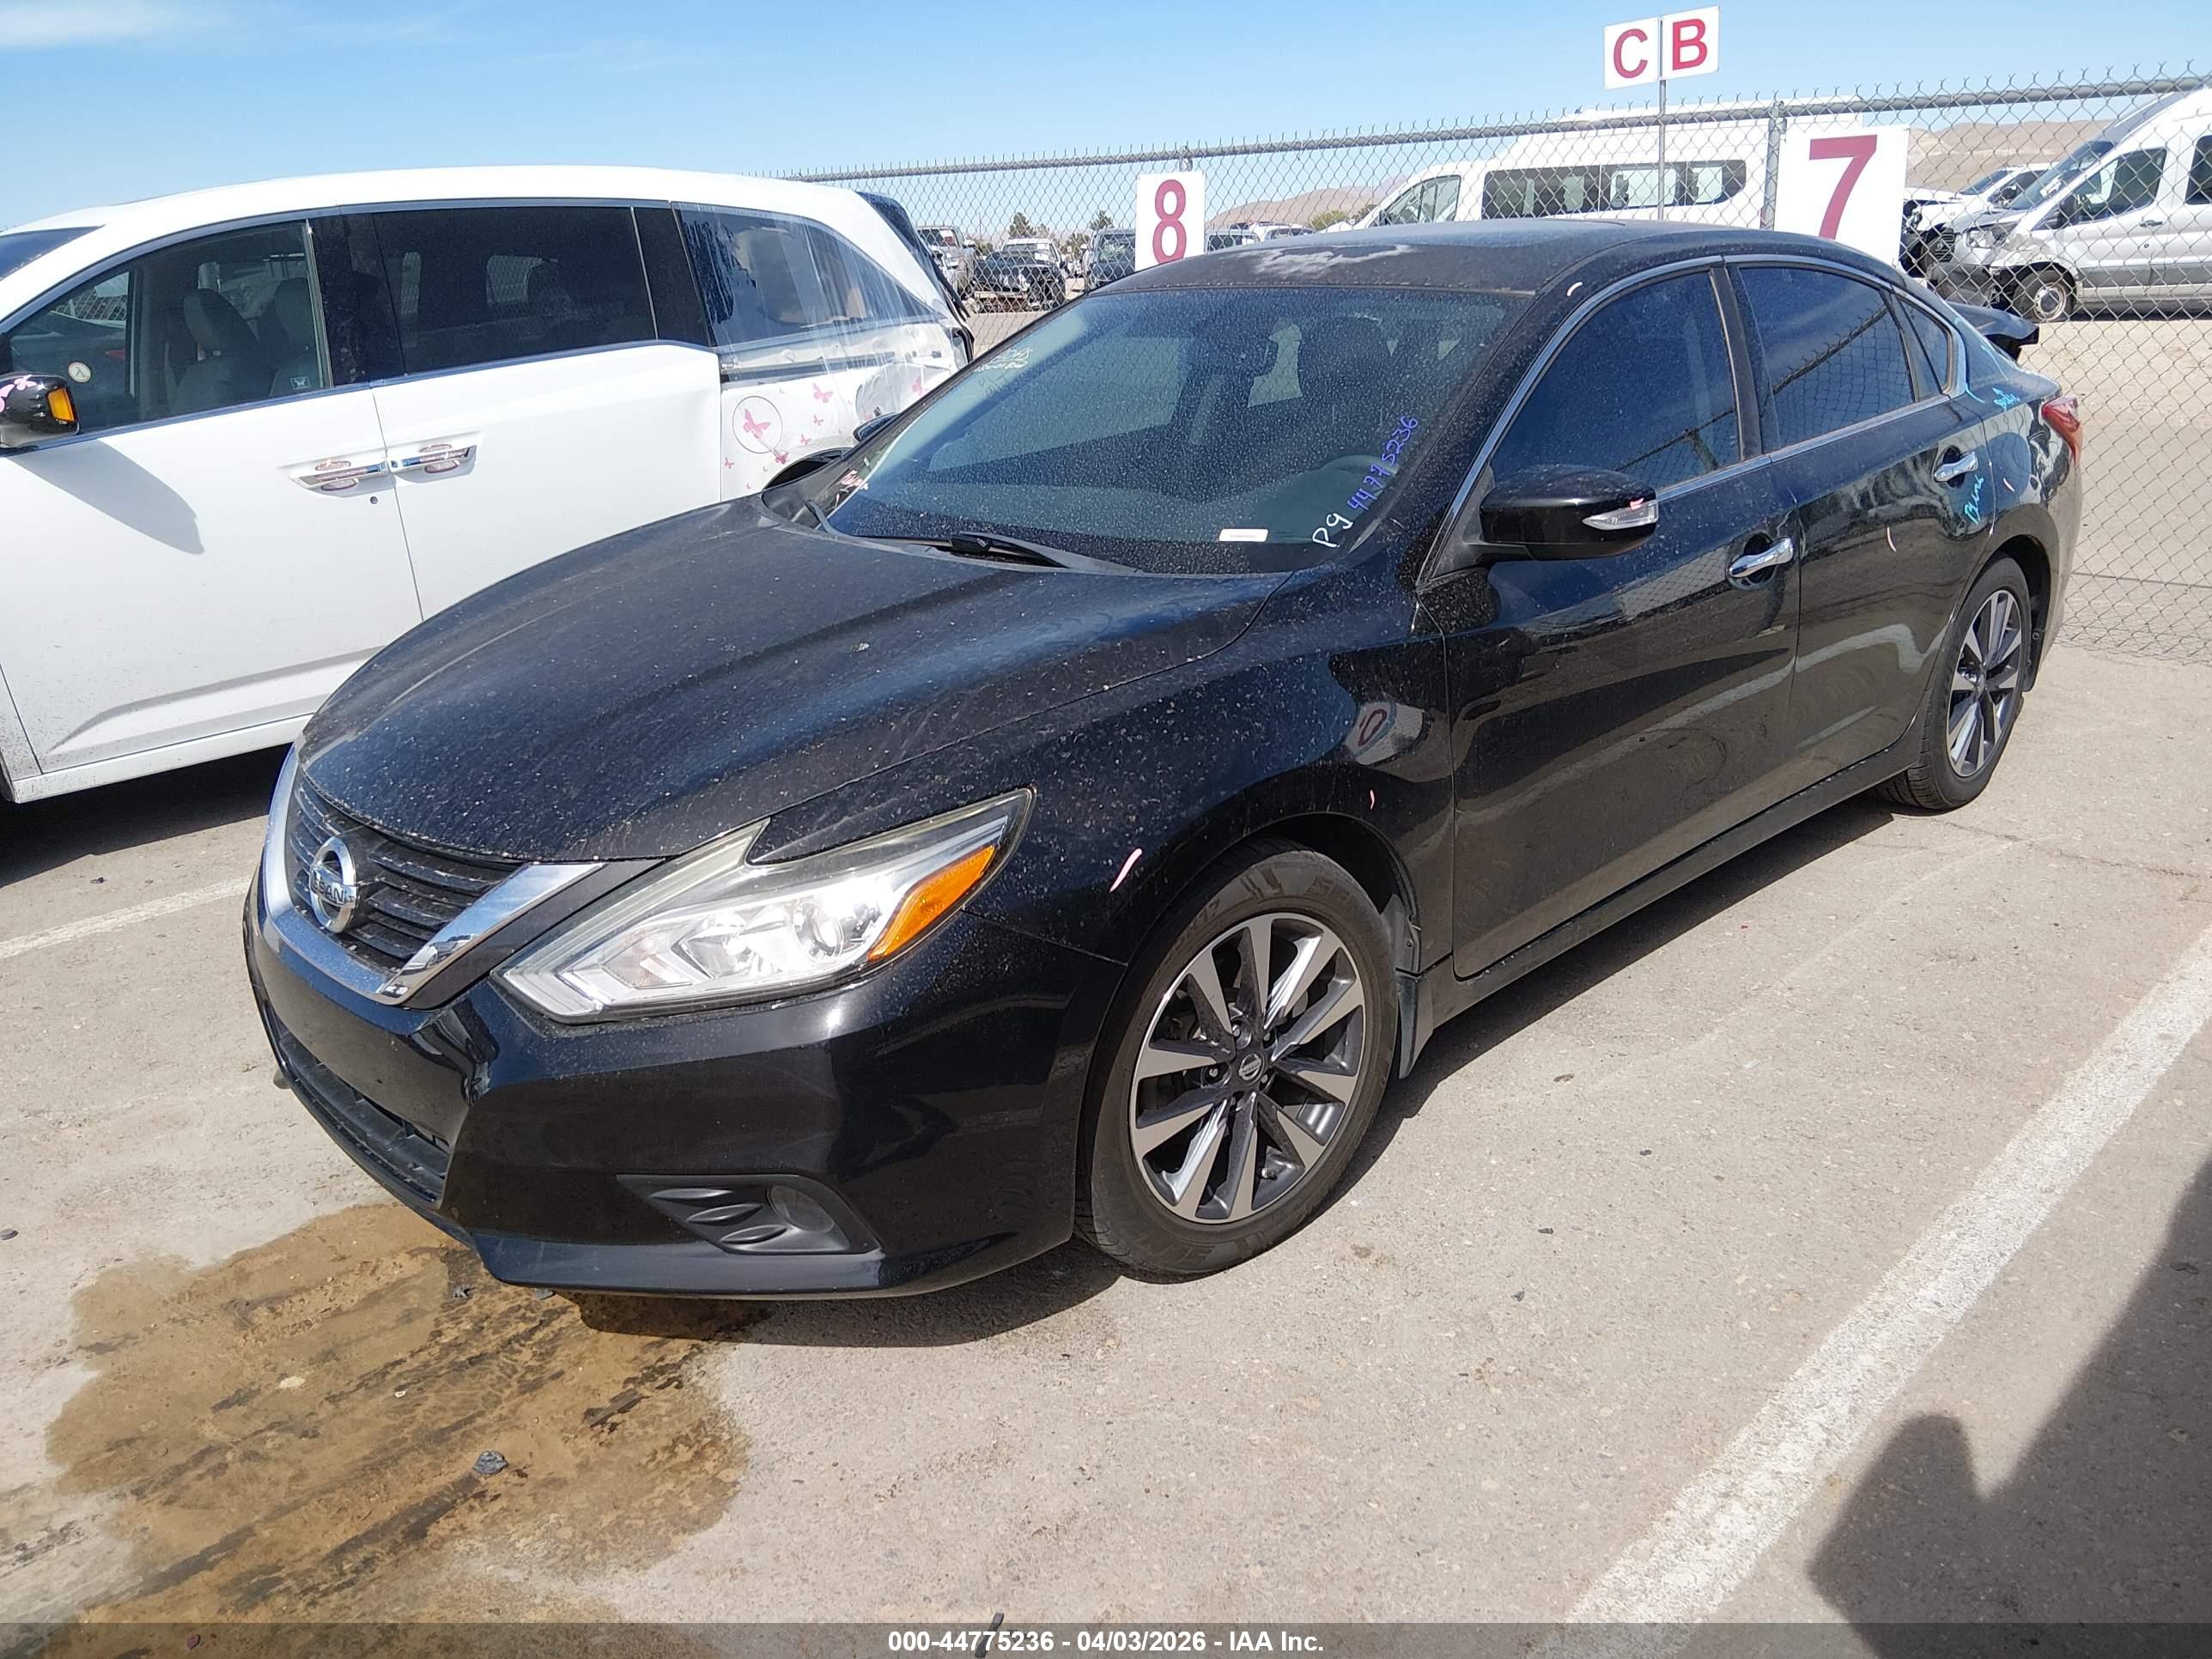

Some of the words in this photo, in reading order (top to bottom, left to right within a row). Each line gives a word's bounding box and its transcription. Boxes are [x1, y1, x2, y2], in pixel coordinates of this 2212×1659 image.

[1613, 28, 1648, 79] C
[1671, 18, 1707, 70] B
[1152, 179, 1187, 264] 8
[1808, 135, 1877, 239] 7
[1346, 416, 1419, 511] 44775236
